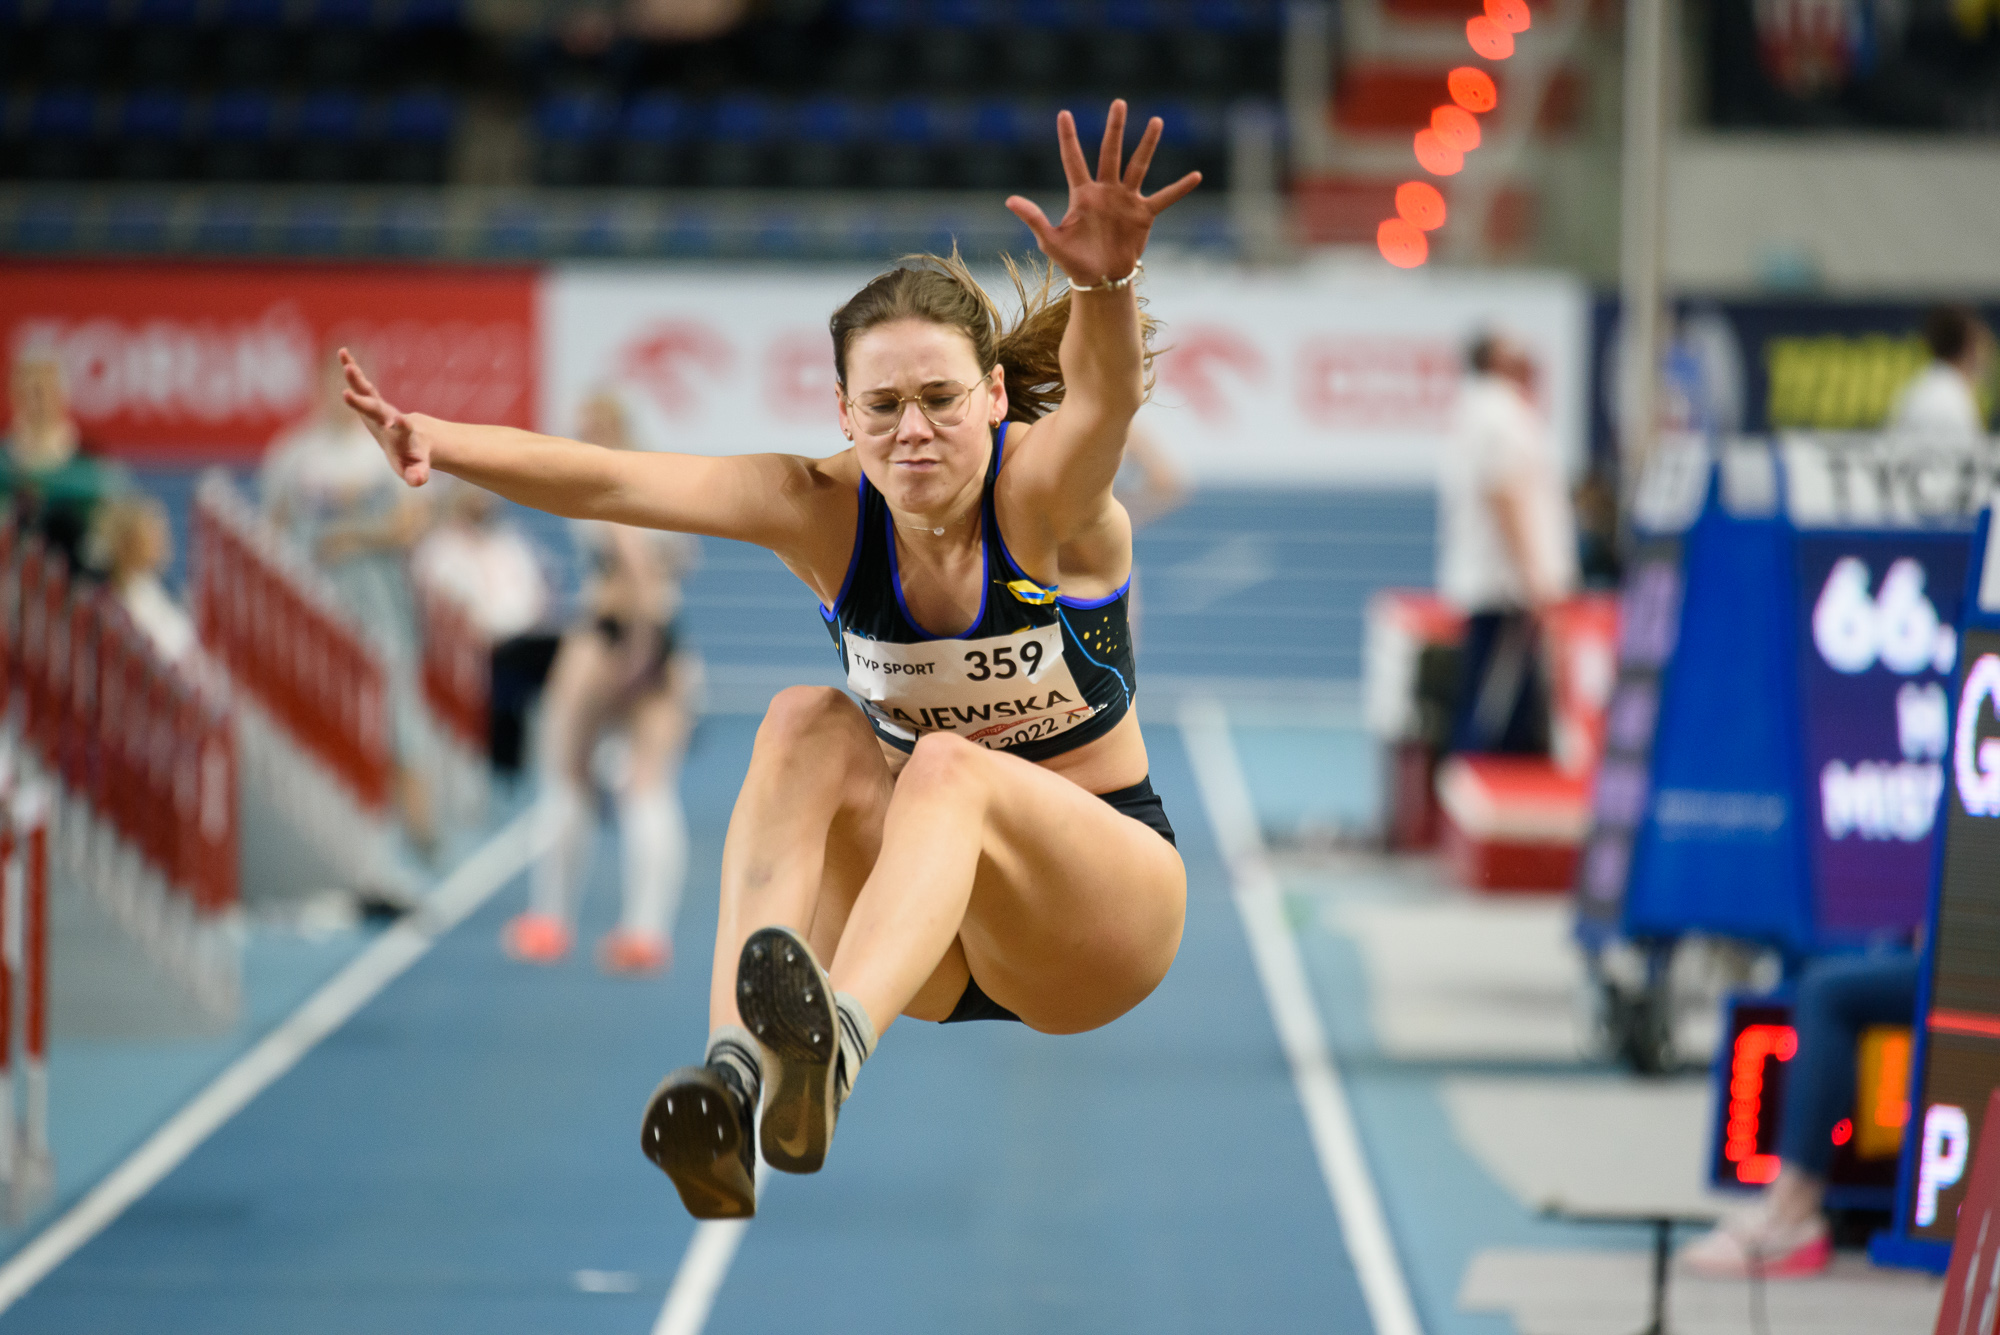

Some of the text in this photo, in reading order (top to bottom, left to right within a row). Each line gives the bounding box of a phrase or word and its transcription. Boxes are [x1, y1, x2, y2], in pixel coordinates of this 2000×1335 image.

[854, 653, 935, 675] TVP SPORT
[964, 640, 1043, 682] 359
[892, 690, 1073, 730] AJEWSKA
